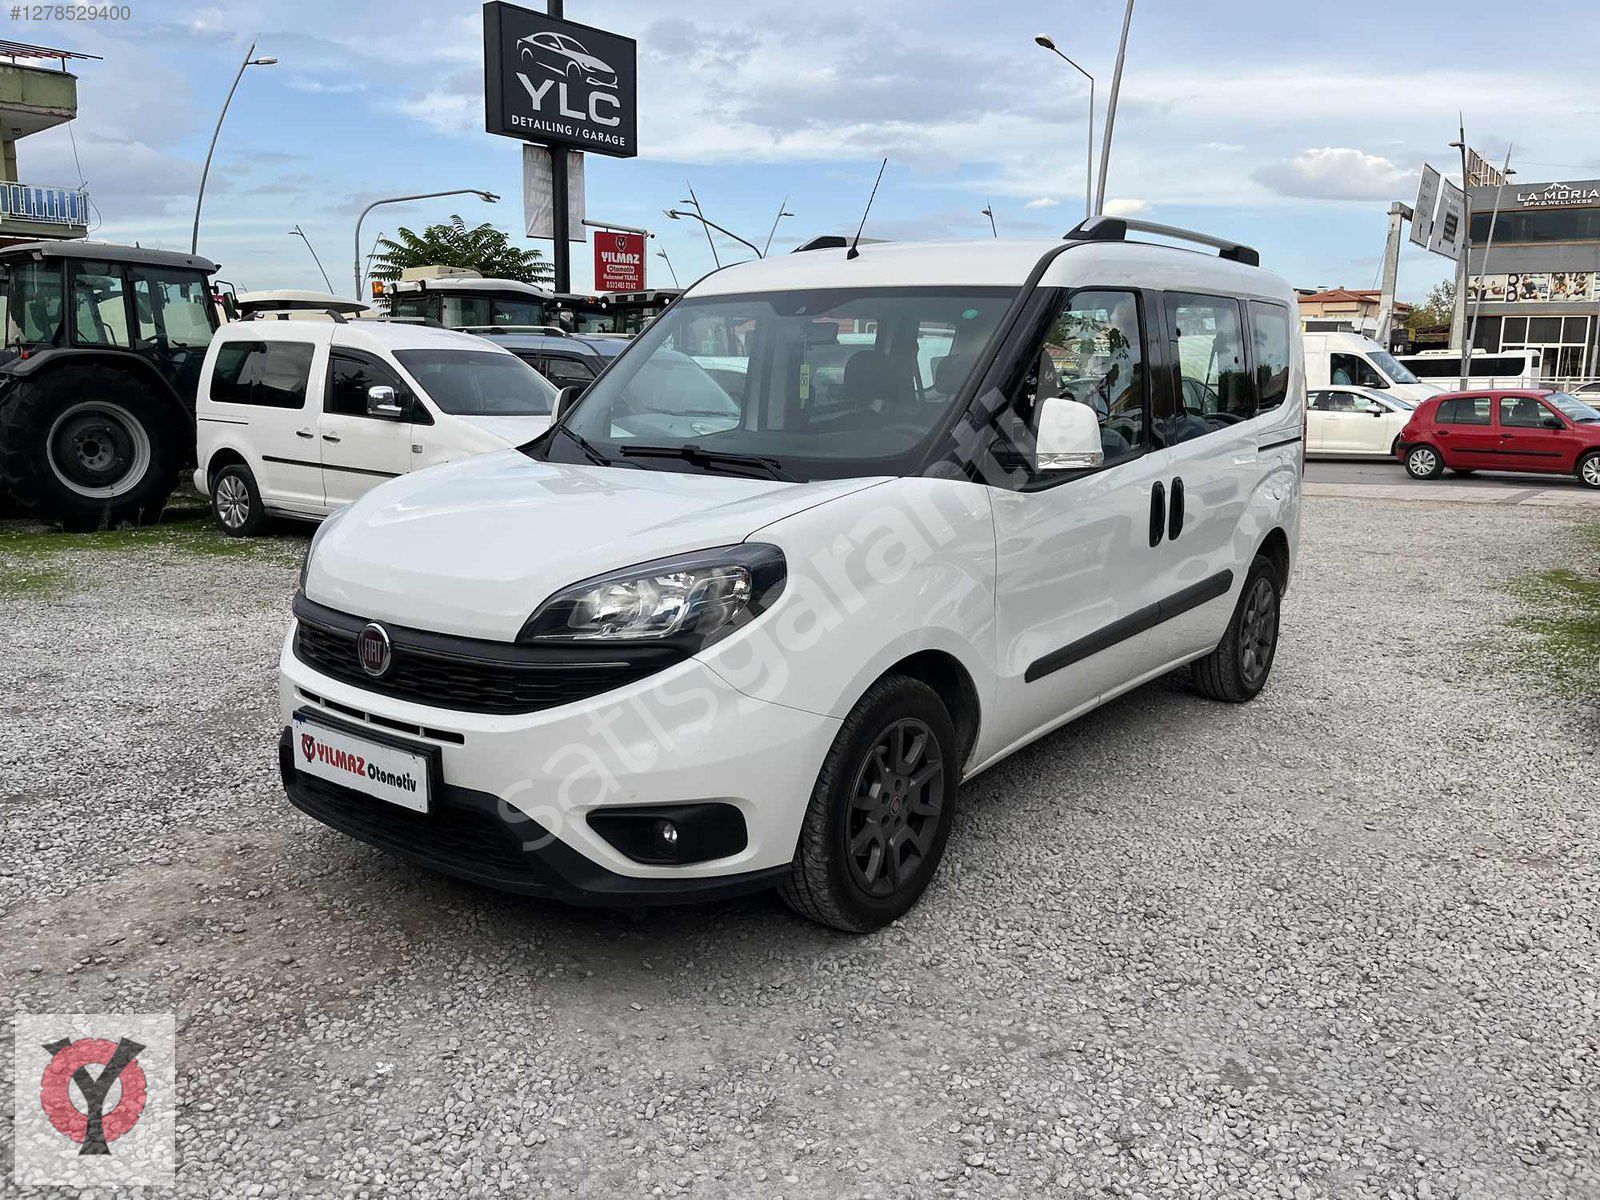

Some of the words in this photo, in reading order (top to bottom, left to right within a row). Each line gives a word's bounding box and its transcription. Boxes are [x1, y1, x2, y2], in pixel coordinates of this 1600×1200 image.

[515, 72, 621, 127] YLC
[511, 114, 573, 135] DETAILING
[582, 129, 626, 147] GARAGE
[1517, 193, 1538, 202] LA
[1544, 189, 1600, 200] MORIA
[601, 251, 640, 264] YILMAZ
[609, 265, 634, 273] Otomotiv
[364, 637, 382, 663] FIAT
[317, 743, 366, 777] YILMAZ
[367, 763, 417, 793] Otomotiv
